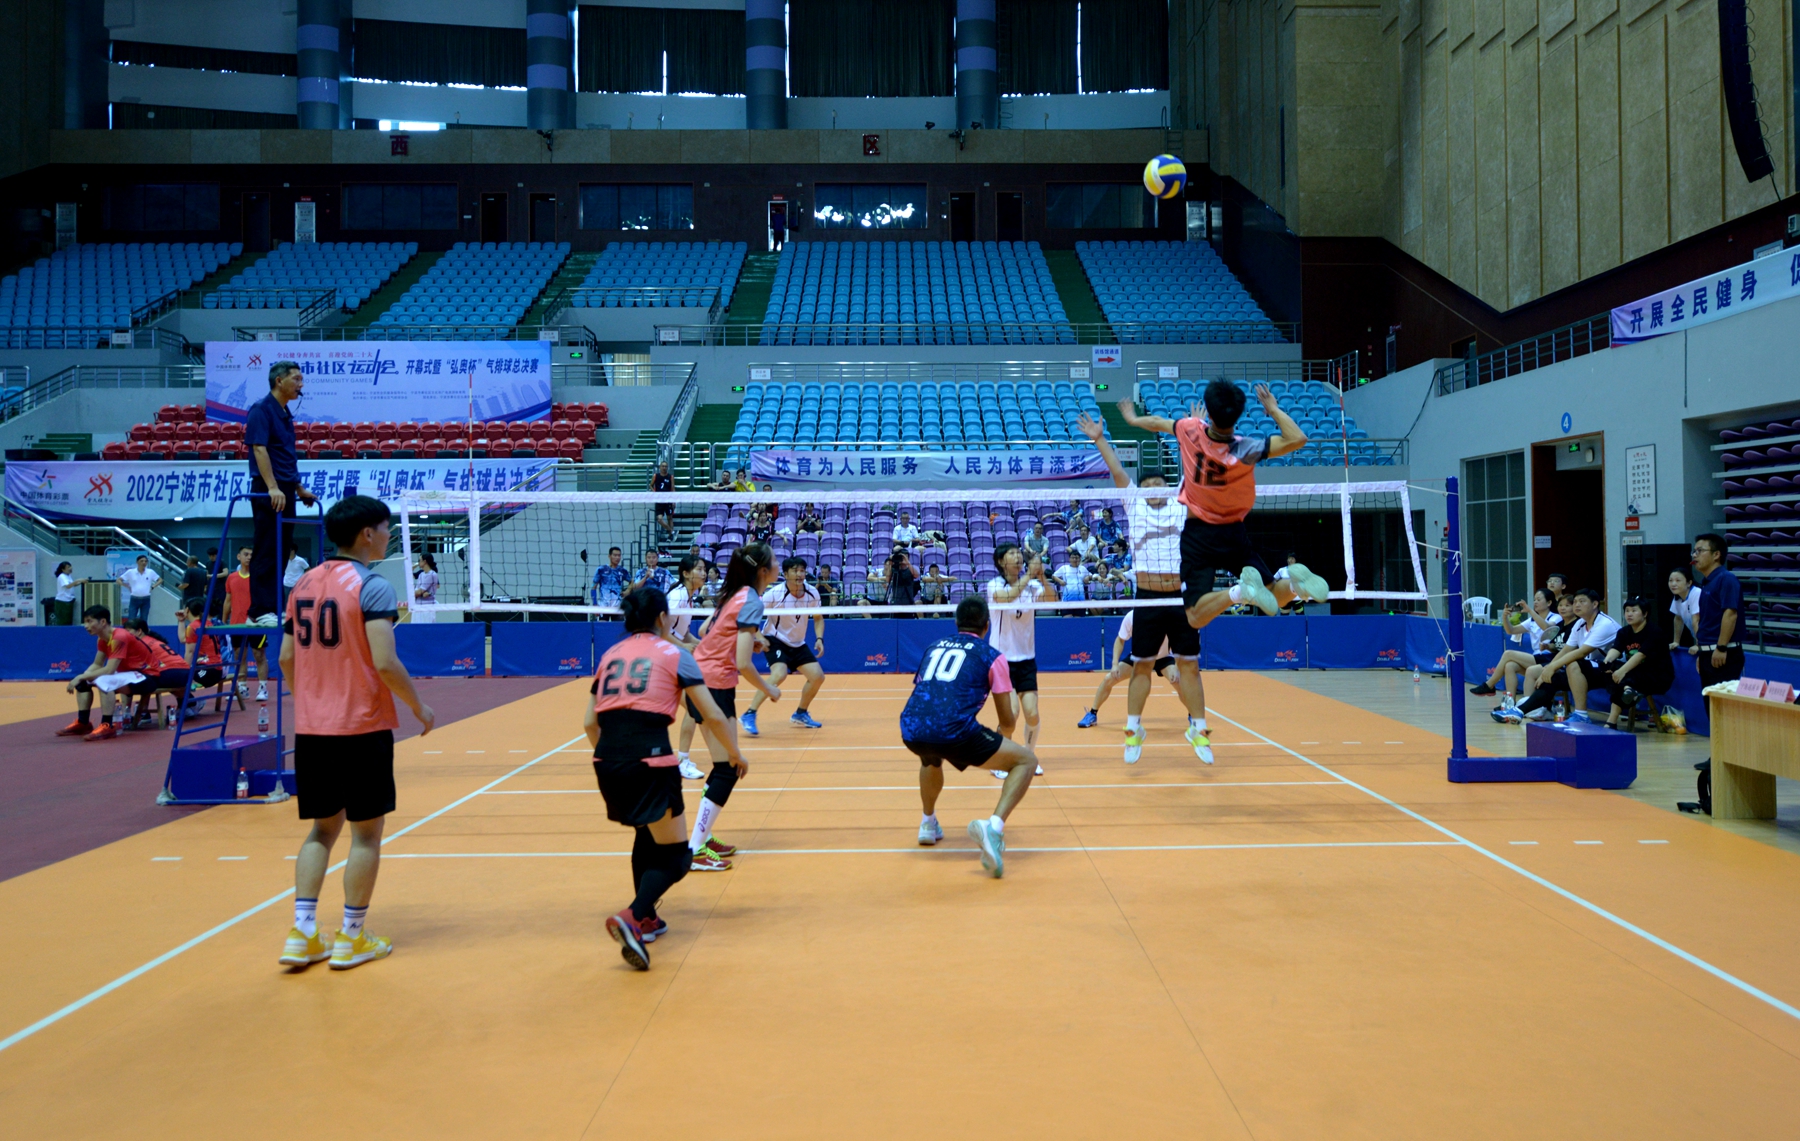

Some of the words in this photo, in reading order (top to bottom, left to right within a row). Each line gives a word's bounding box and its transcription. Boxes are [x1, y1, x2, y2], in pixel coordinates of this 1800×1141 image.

[390, 135, 410, 156] 西
[862, 134, 881, 156] 区
[1630, 269, 1757, 334] 开展全民健身
[1562, 415, 1569, 429] 4
[775, 456, 918, 476] 体育为人民服务
[944, 454, 1087, 474] 人民为体育添彩
[1193, 451, 1228, 487] 12
[20, 491, 69, 500] 中国体育彩票
[295, 597, 342, 649] 50
[776, 649, 782, 658] 9
[922, 648, 967, 682] 10
[602, 657, 652, 696] 29
